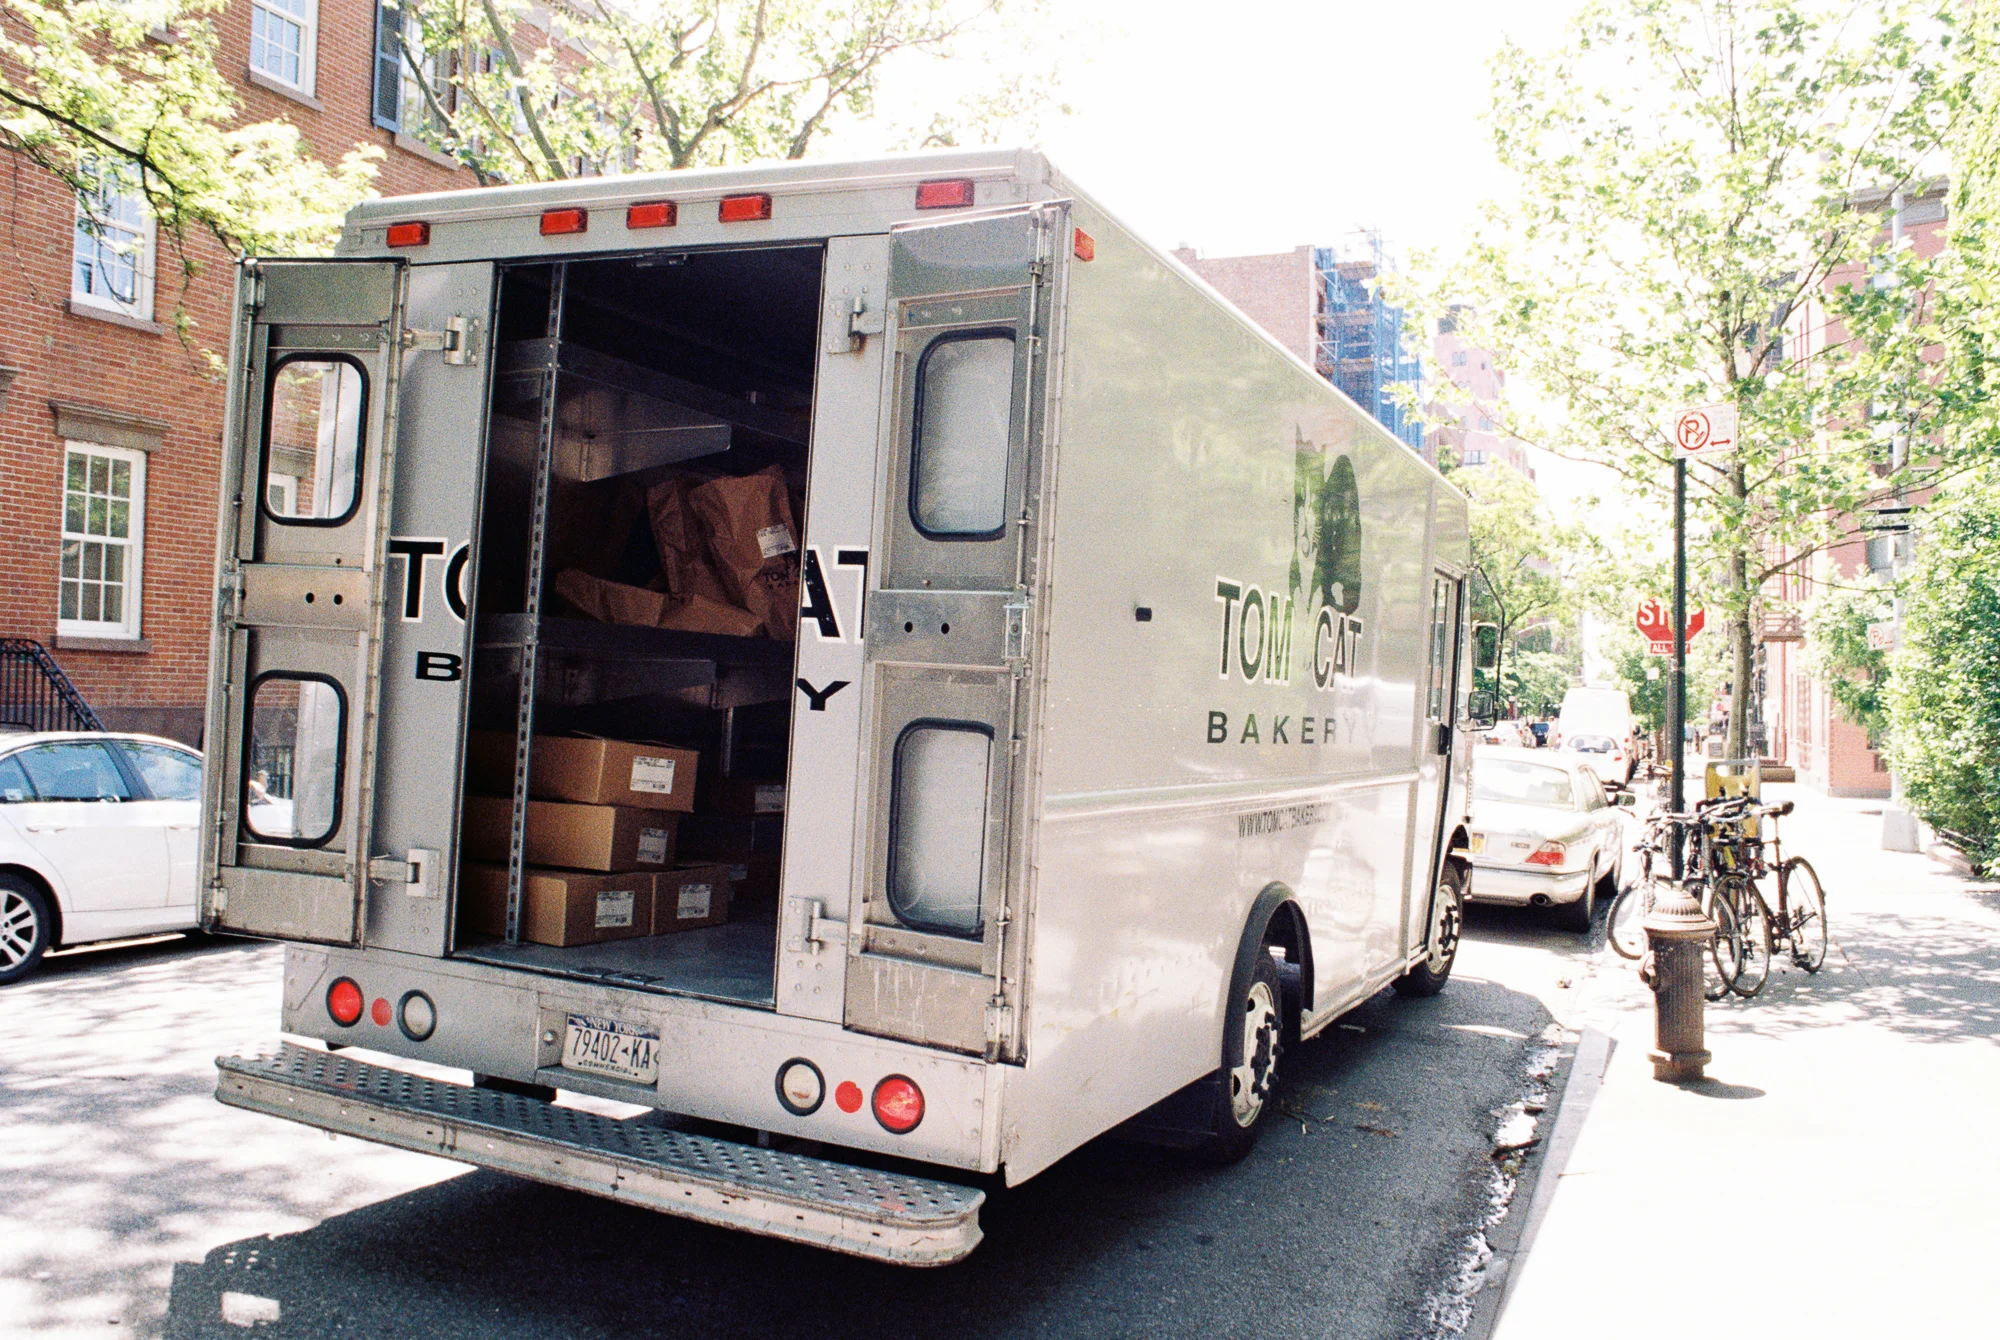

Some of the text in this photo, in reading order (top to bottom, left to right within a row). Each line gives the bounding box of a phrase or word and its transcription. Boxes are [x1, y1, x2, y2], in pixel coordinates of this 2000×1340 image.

[1639, 598, 1703, 626] STP
[1215, 575, 1363, 694] TOM CAT
[1652, 644, 1669, 653] ALL
[1207, 710, 1358, 745] BAKERY
